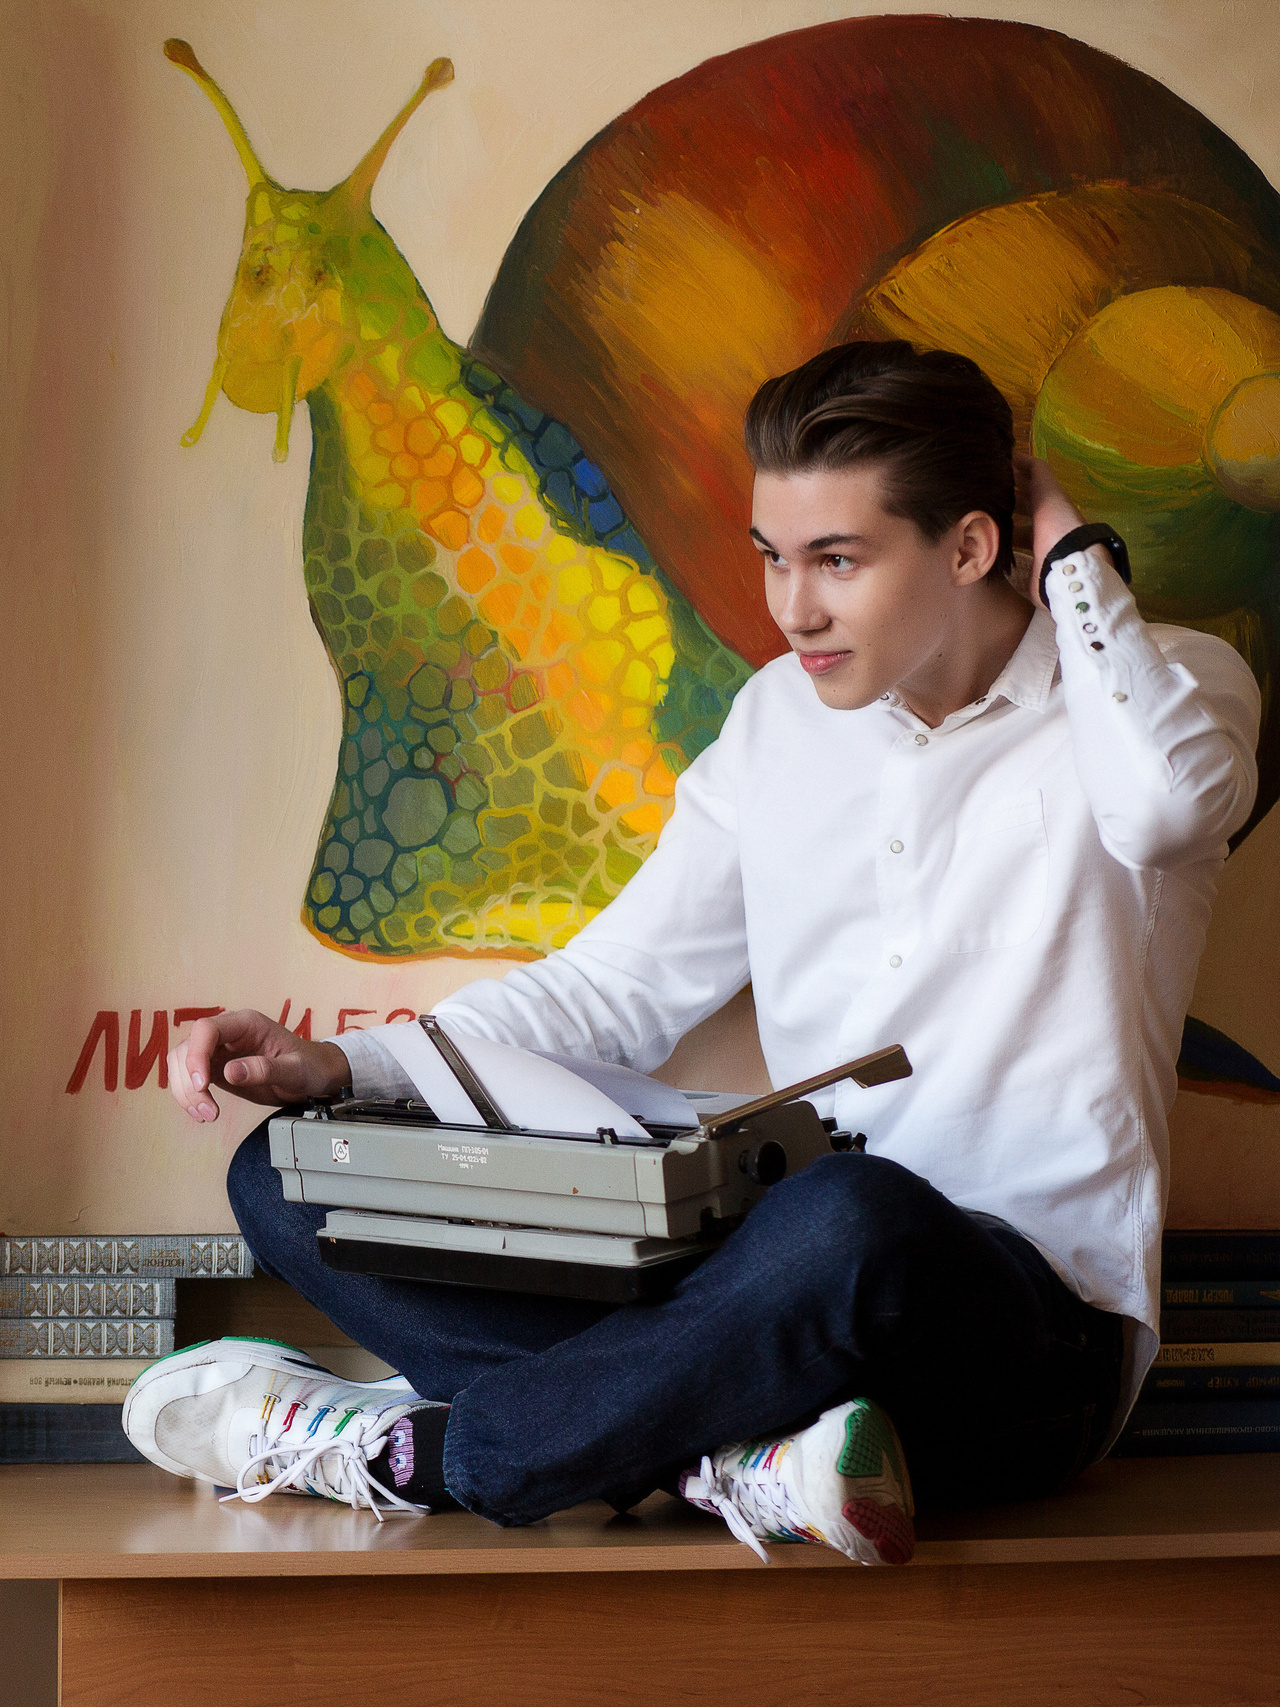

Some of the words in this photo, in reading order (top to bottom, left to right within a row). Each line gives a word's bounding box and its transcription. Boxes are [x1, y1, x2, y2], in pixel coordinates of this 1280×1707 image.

[1165, 1288, 1200, 1303] ГОВАРД
[1202, 1289, 1234, 1303] РОБЕРТ
[29, 1377, 43, 1386] ЗОВ
[44, 1377, 72, 1387] ВЕЧНЫЙ
[79, 1377, 106, 1386] ИВАНОВ
[1207, 1376, 1240, 1389] КУПЕР
[1142, 1427, 1185, 1436] АКАДЕМИЯ
